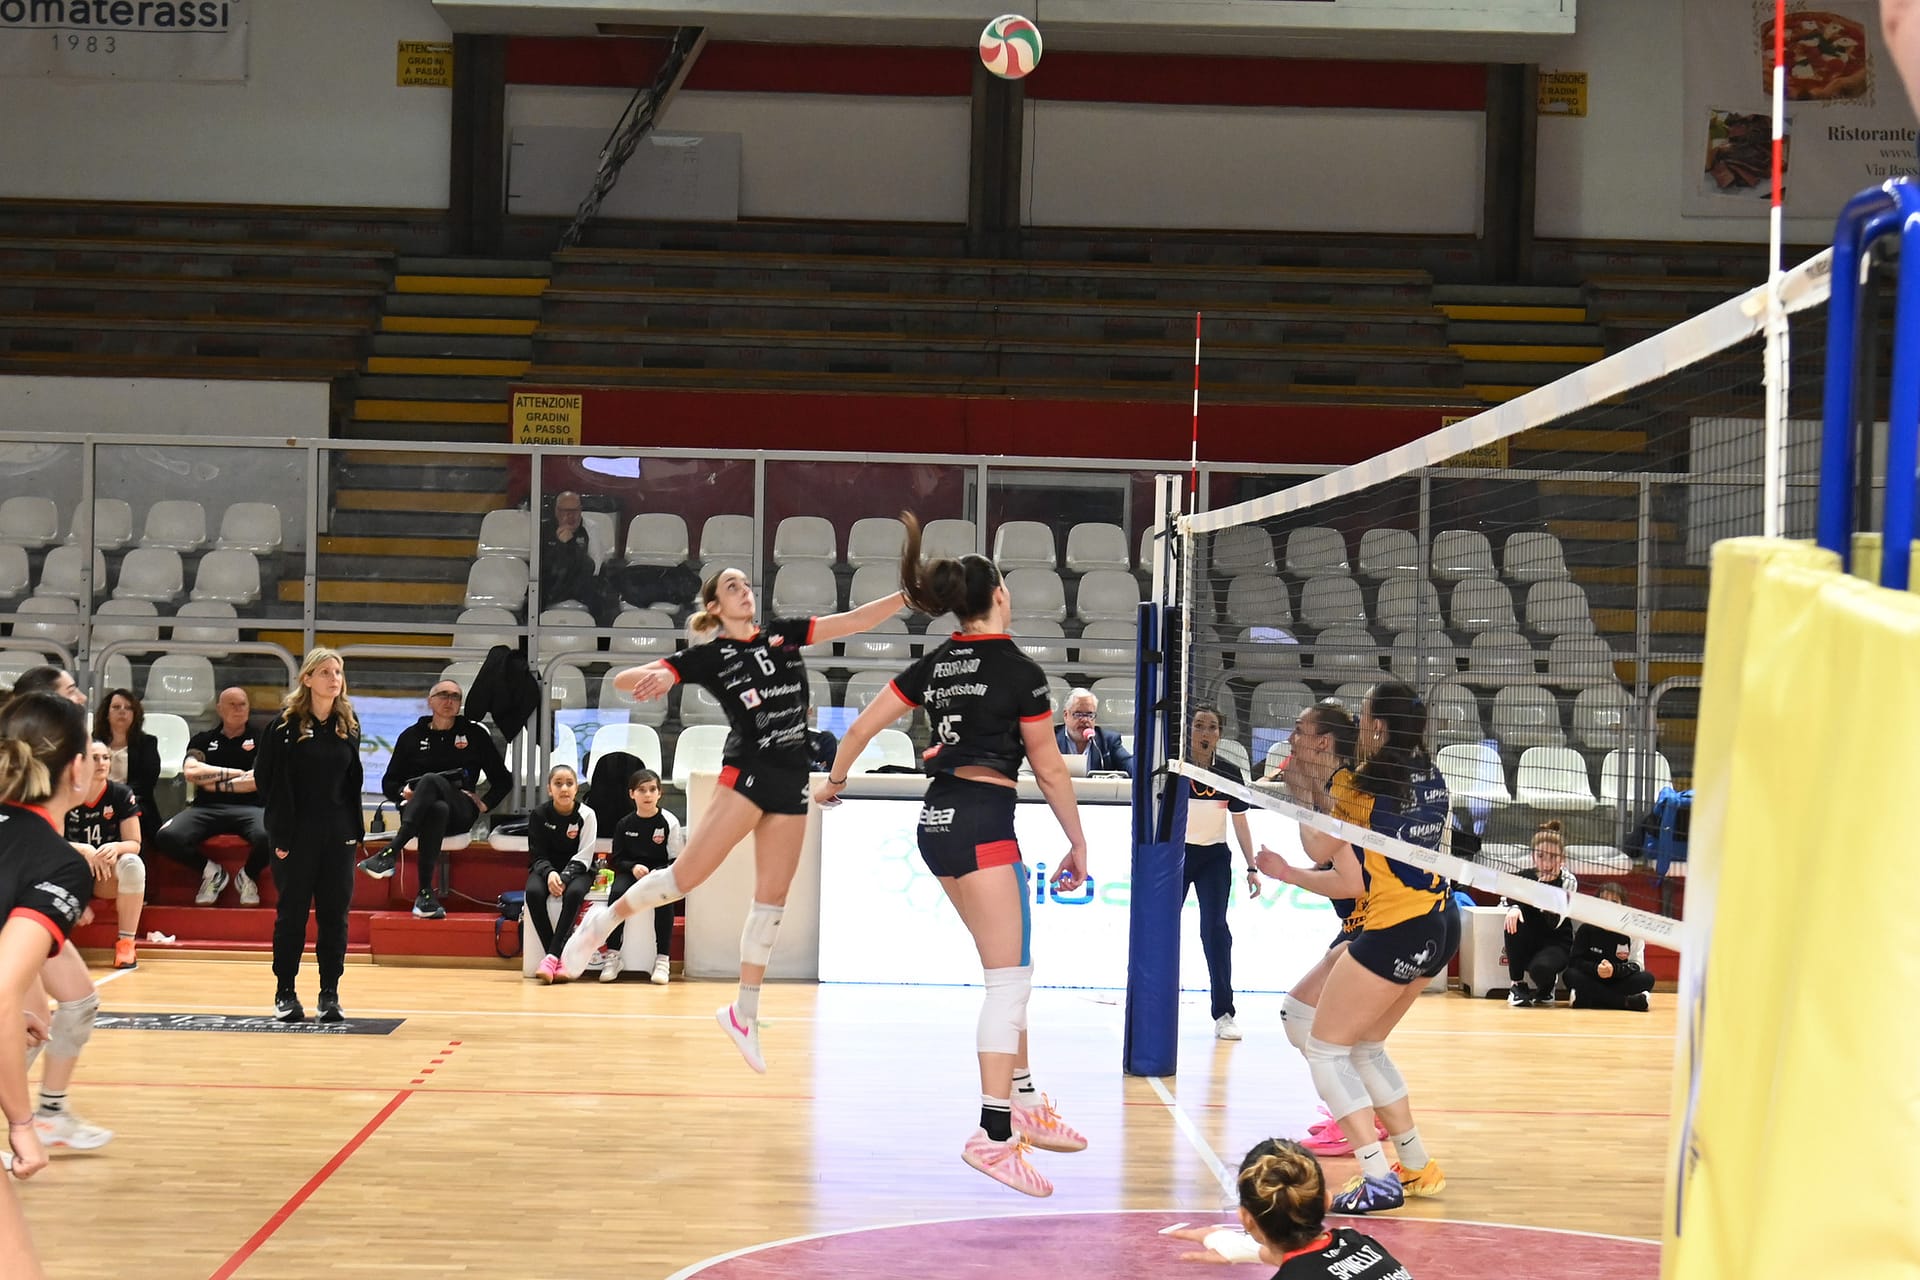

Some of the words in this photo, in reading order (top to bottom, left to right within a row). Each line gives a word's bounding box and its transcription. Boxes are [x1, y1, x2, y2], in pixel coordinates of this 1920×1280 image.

[51, 35, 116, 53] 1983
[1828, 125, 1916, 142] Ristorante
[1865, 163, 1886, 177] Via
[516, 396, 580, 409] ATTENZIONE
[526, 412, 570, 422] GRADINI
[523, 424, 530, 433] A
[536, 424, 570, 434] PASSO
[754, 646, 776, 676] 6
[84, 823, 103, 845] 14
